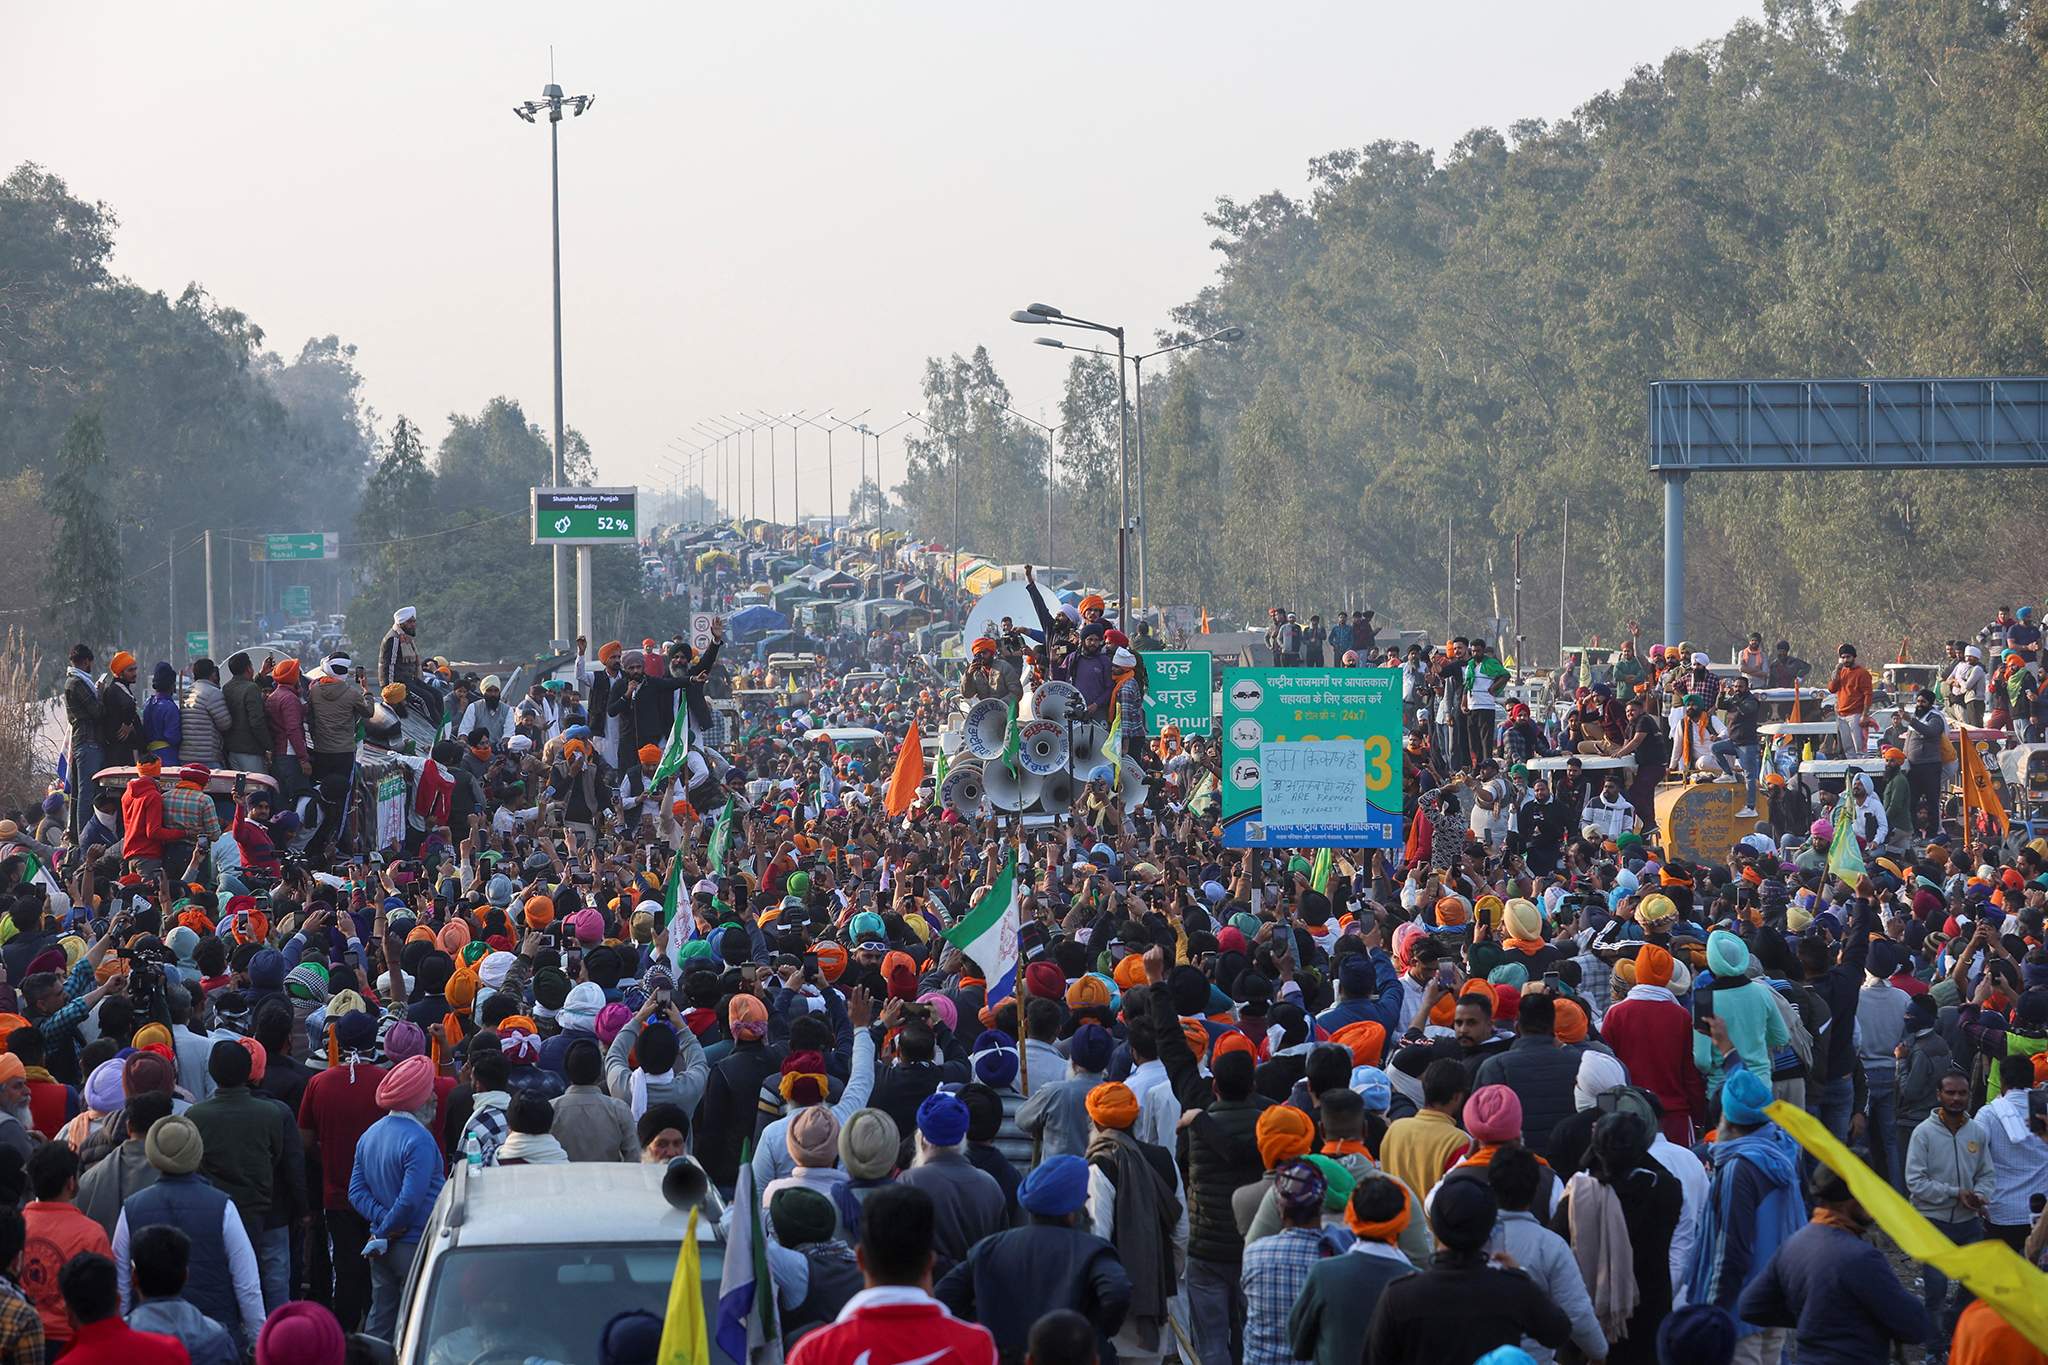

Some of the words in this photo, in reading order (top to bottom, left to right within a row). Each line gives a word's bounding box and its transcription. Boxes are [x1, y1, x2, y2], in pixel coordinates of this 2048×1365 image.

[600, 495, 619, 503] Punjab
[1267, 674, 1293, 689] राष्ट्रीय
[1331, 677, 1343, 688] पर
[1156, 690, 1198, 709] बनूड़
[1279, 694, 1311, 704] सहायता
[1312, 691, 1322, 704] के
[1323, 691, 1340, 706] लिए
[1342, 694, 1366, 704] डायल
[1368, 691, 1383, 704] करें
[1156, 714, 1209, 728] Banur
[1266, 792, 1284, 804] WE
[1290, 791, 1311, 801] ARE
